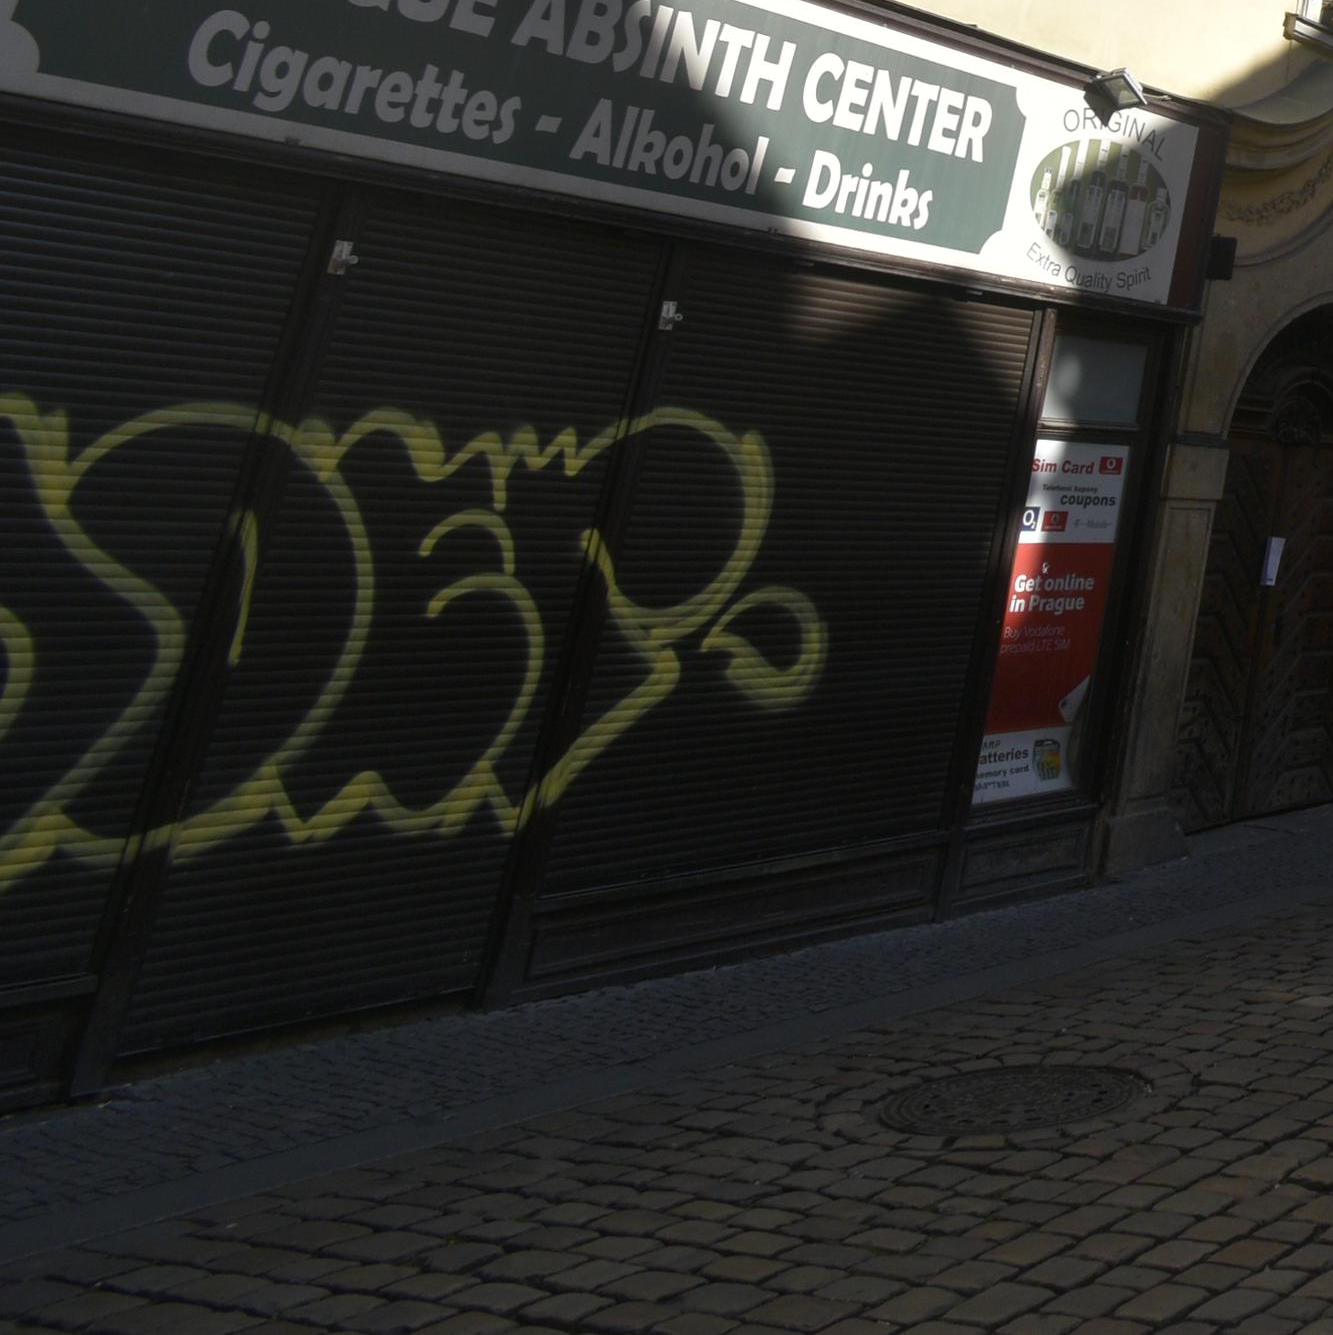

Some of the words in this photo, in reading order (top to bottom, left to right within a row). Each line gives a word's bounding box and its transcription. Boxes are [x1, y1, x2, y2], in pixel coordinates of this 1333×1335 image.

[803, 52, 993, 163] CENTER
[188, 10, 522, 144] Cigarettes
[570, 99, 769, 195] Alkohol
[802, 150, 932, 230] Drinks
[1063, 107, 1166, 161] ORGINAL
[1026, 242, 1060, 277] Extra
[1064, 265, 1113, 294] Quality
[1116, 267, 1152, 290] Spirit
[1031, 459, 1057, 473] Sim
[1062, 460, 1095, 475] Card
[1060, 495, 1116, 509] coupons
[1015, 574, 1042, 592] Get
[1044, 572, 1095, 591] online
[1009, 595, 1026, 612] in
[1028, 594, 1086, 615] Prague
[1003, 626, 1021, 641] Buy
[979, 747, 1029, 765] atteries
